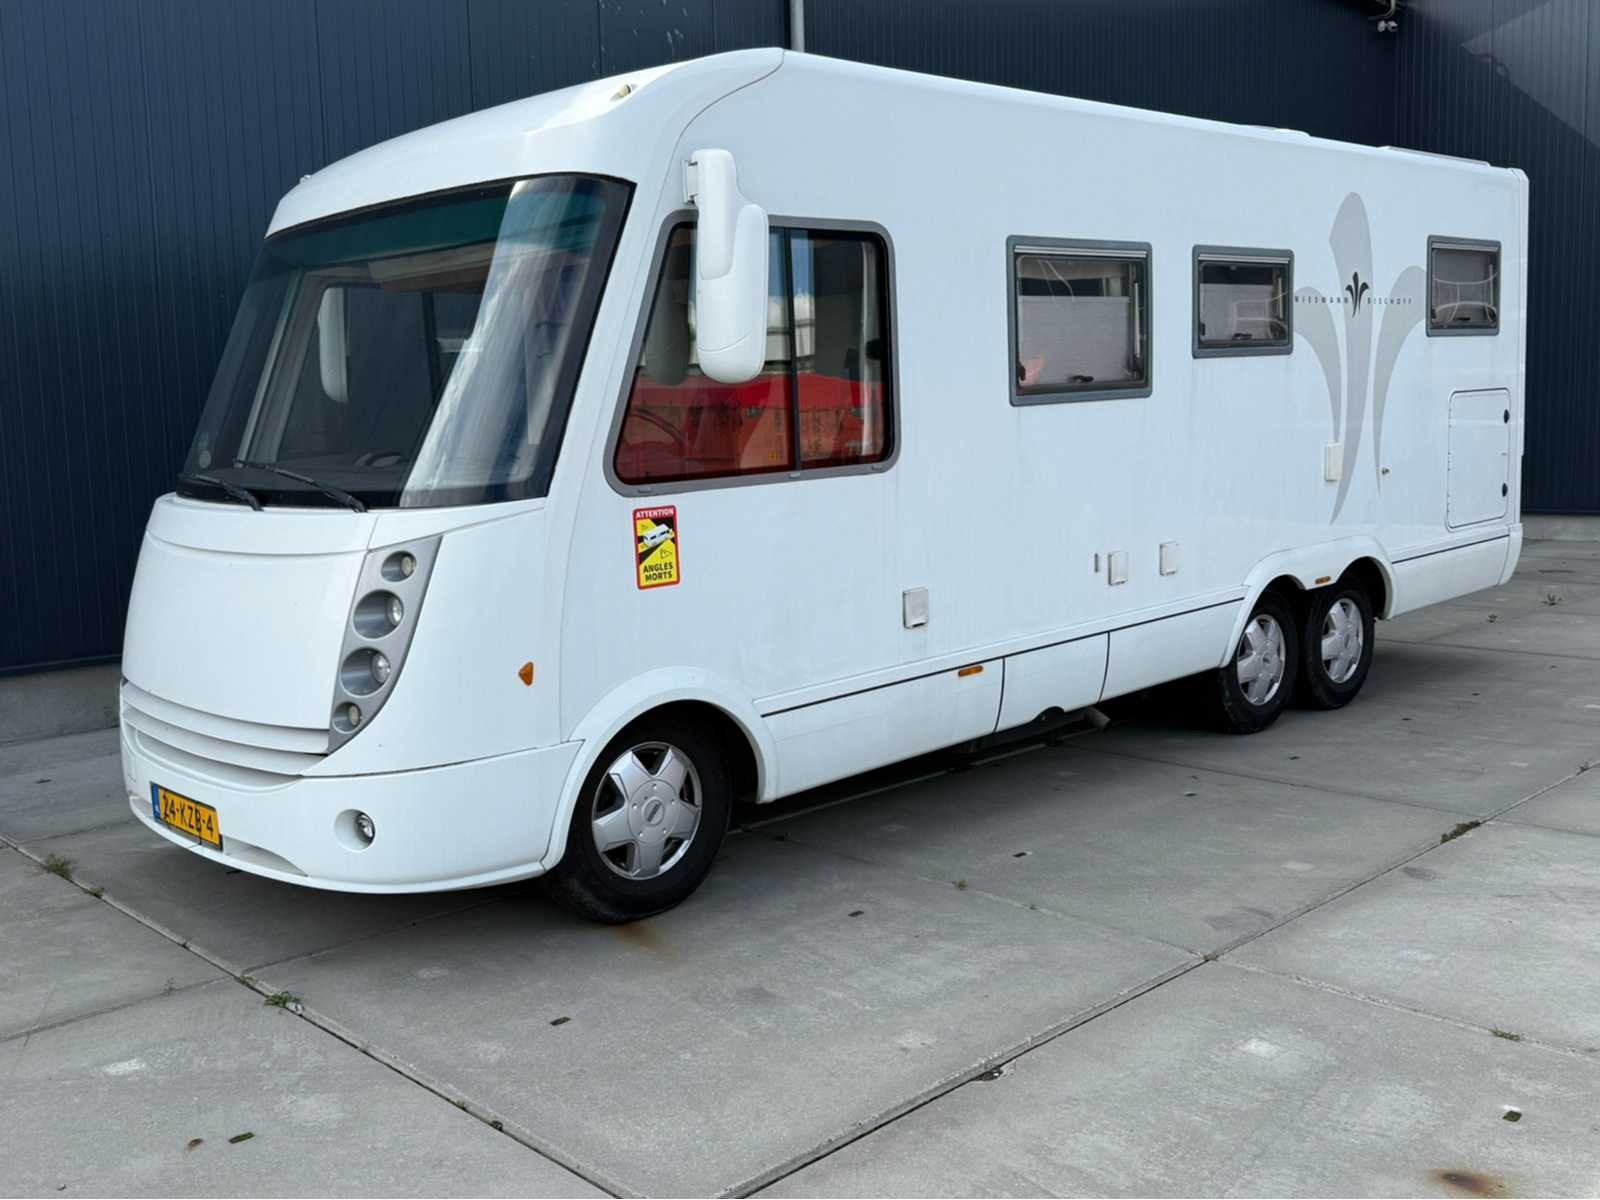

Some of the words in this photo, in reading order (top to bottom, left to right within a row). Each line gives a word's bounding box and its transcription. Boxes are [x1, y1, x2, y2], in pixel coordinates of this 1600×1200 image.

[636, 508, 674, 518] ATTENTION
[643, 562, 673, 573] ANGLES
[644, 571, 673, 581] MORTS
